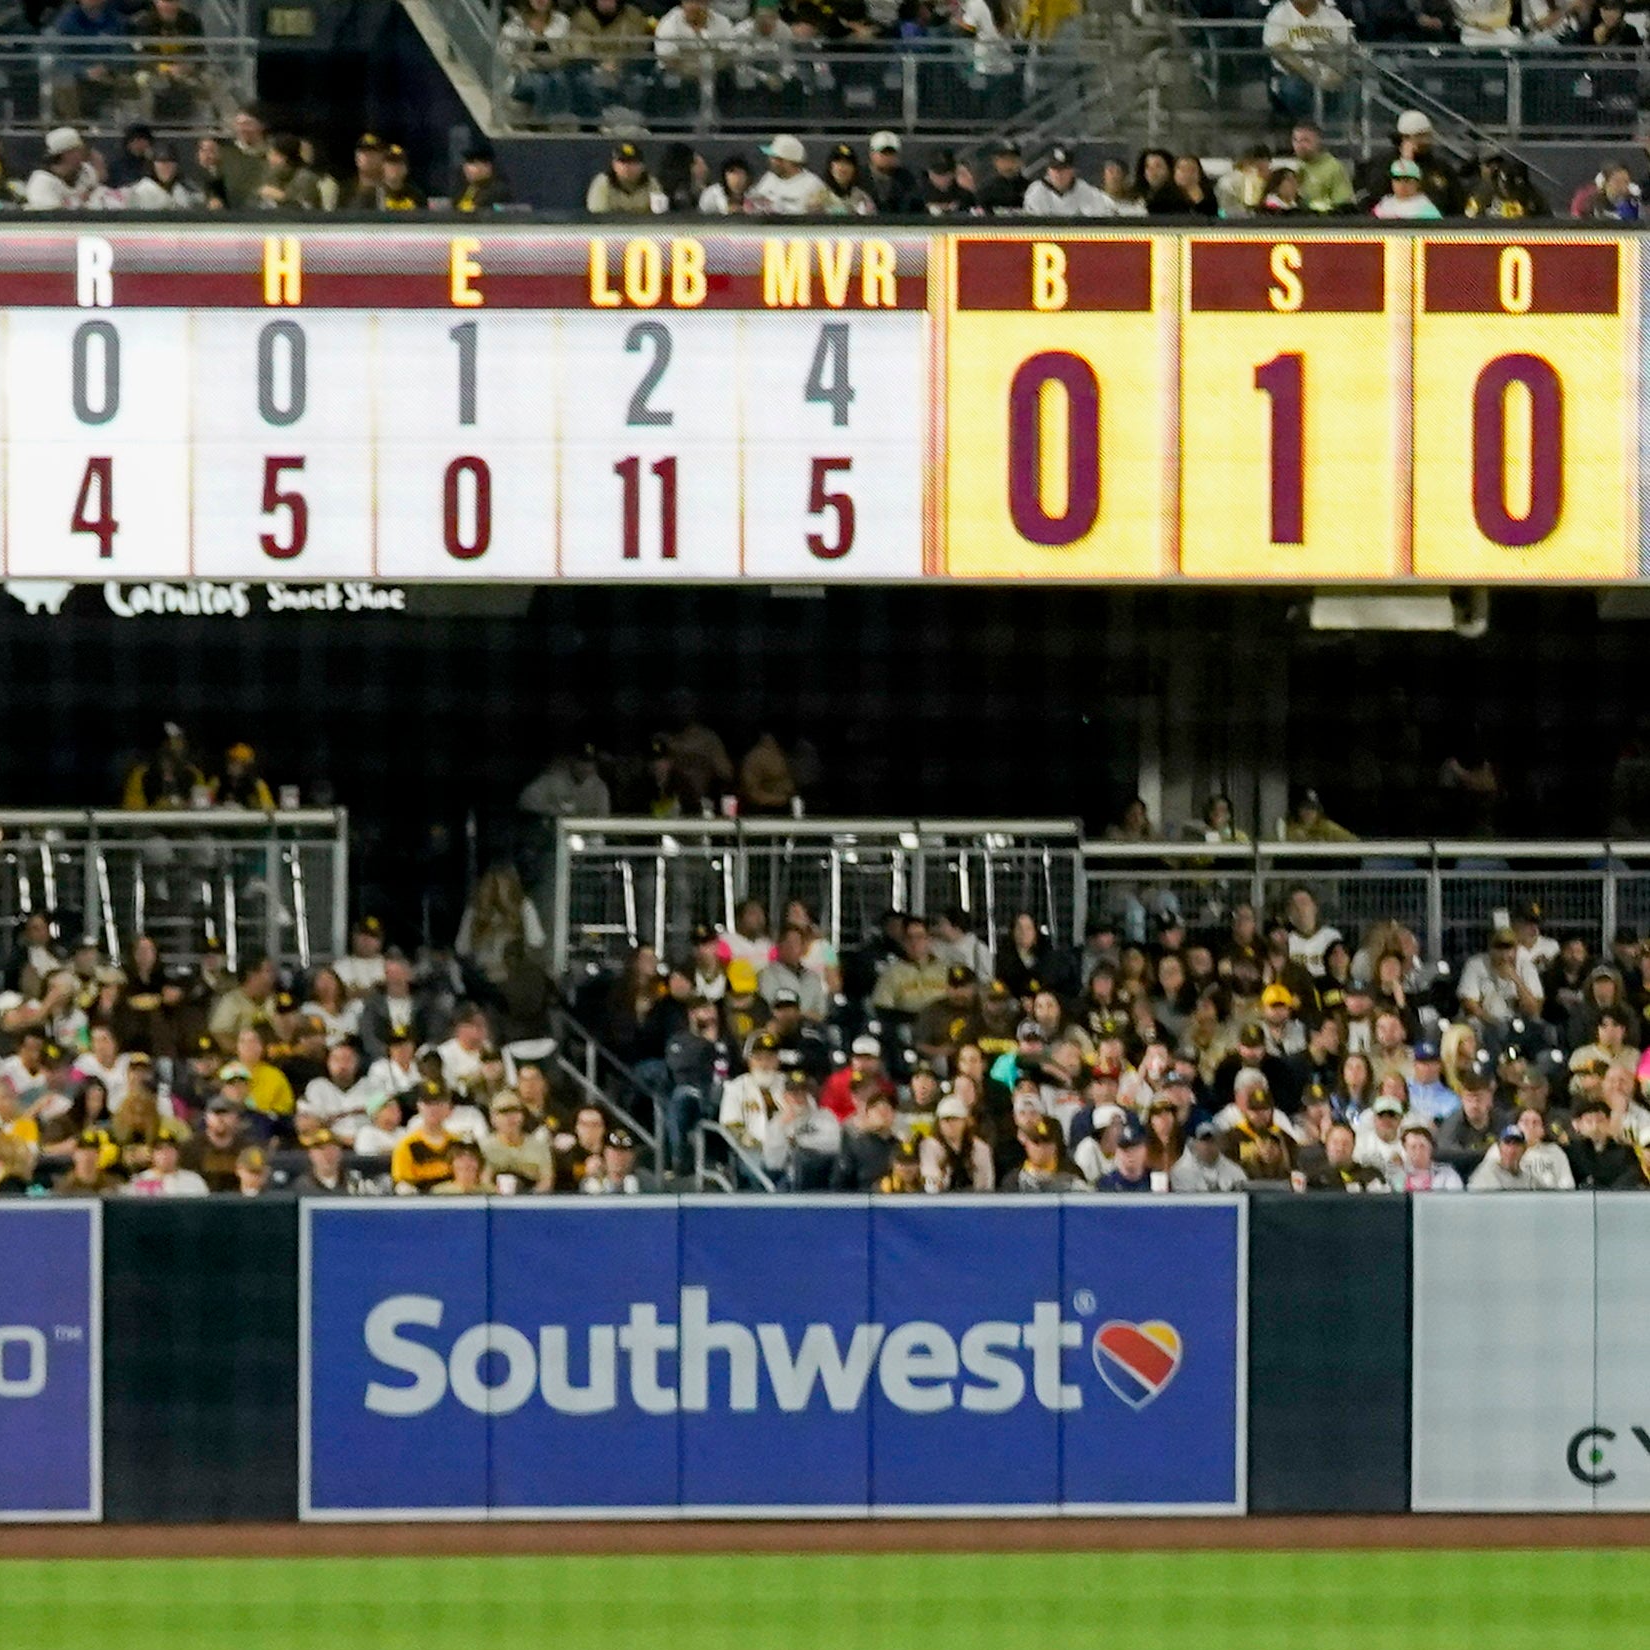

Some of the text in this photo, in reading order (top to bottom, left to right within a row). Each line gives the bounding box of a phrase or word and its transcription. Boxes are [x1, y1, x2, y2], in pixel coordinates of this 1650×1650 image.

[75, 238, 114, 307] R
[262, 238, 302, 306] H
[450, 238, 484, 306] E
[589, 239, 708, 308] LOB
[763, 240, 898, 308] MVR
[1031, 244, 1068, 310] B
[1269, 245, 1303, 311] S
[72, 320, 120, 427] 0
[257, 320, 307, 427] 0
[448, 322, 478, 425] 1
[624, 321, 673, 426] 2
[804, 322, 855, 427] 4
[1008, 350, 1101, 547] 0
[1253, 352, 1305, 545] 1
[1471, 352, 1565, 548] 0
[70, 455, 119, 559] 4
[259, 456, 307, 560] 5
[443, 455, 491, 560] 0
[612, 456, 677, 559] 11
[805, 456, 855, 559] 5
[363, 1284, 1082, 1418] Southwest
